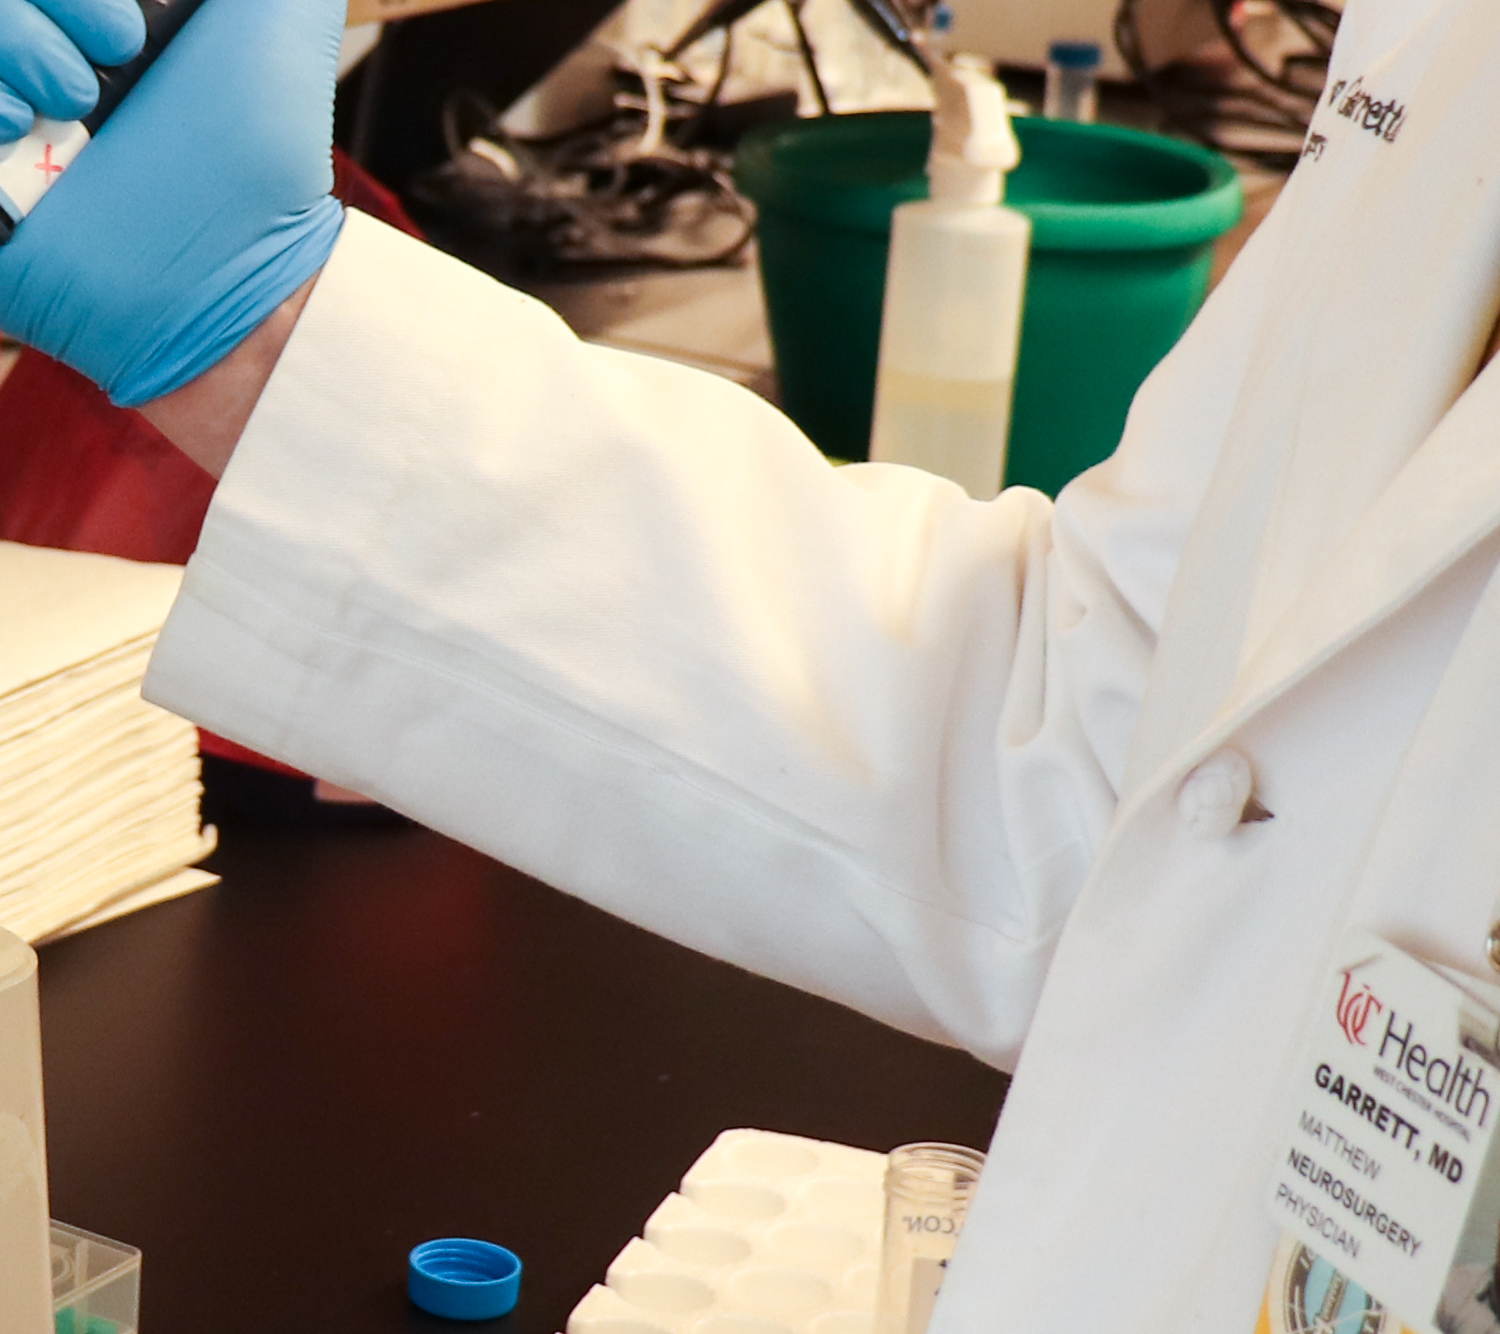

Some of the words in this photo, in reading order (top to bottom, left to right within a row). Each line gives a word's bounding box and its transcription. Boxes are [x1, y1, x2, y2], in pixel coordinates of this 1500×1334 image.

[1315, 1063, 1420, 1161] GARRETT,
[1429, 1143, 1464, 1183] MD
[1379, 1010, 1490, 1127] Health
[1298, 1110, 1381, 1180] MATTHEW
[1276, 1181, 1361, 1258] PHYSICIAN
[1288, 1147, 1421, 1257] NEUROSURGERY
